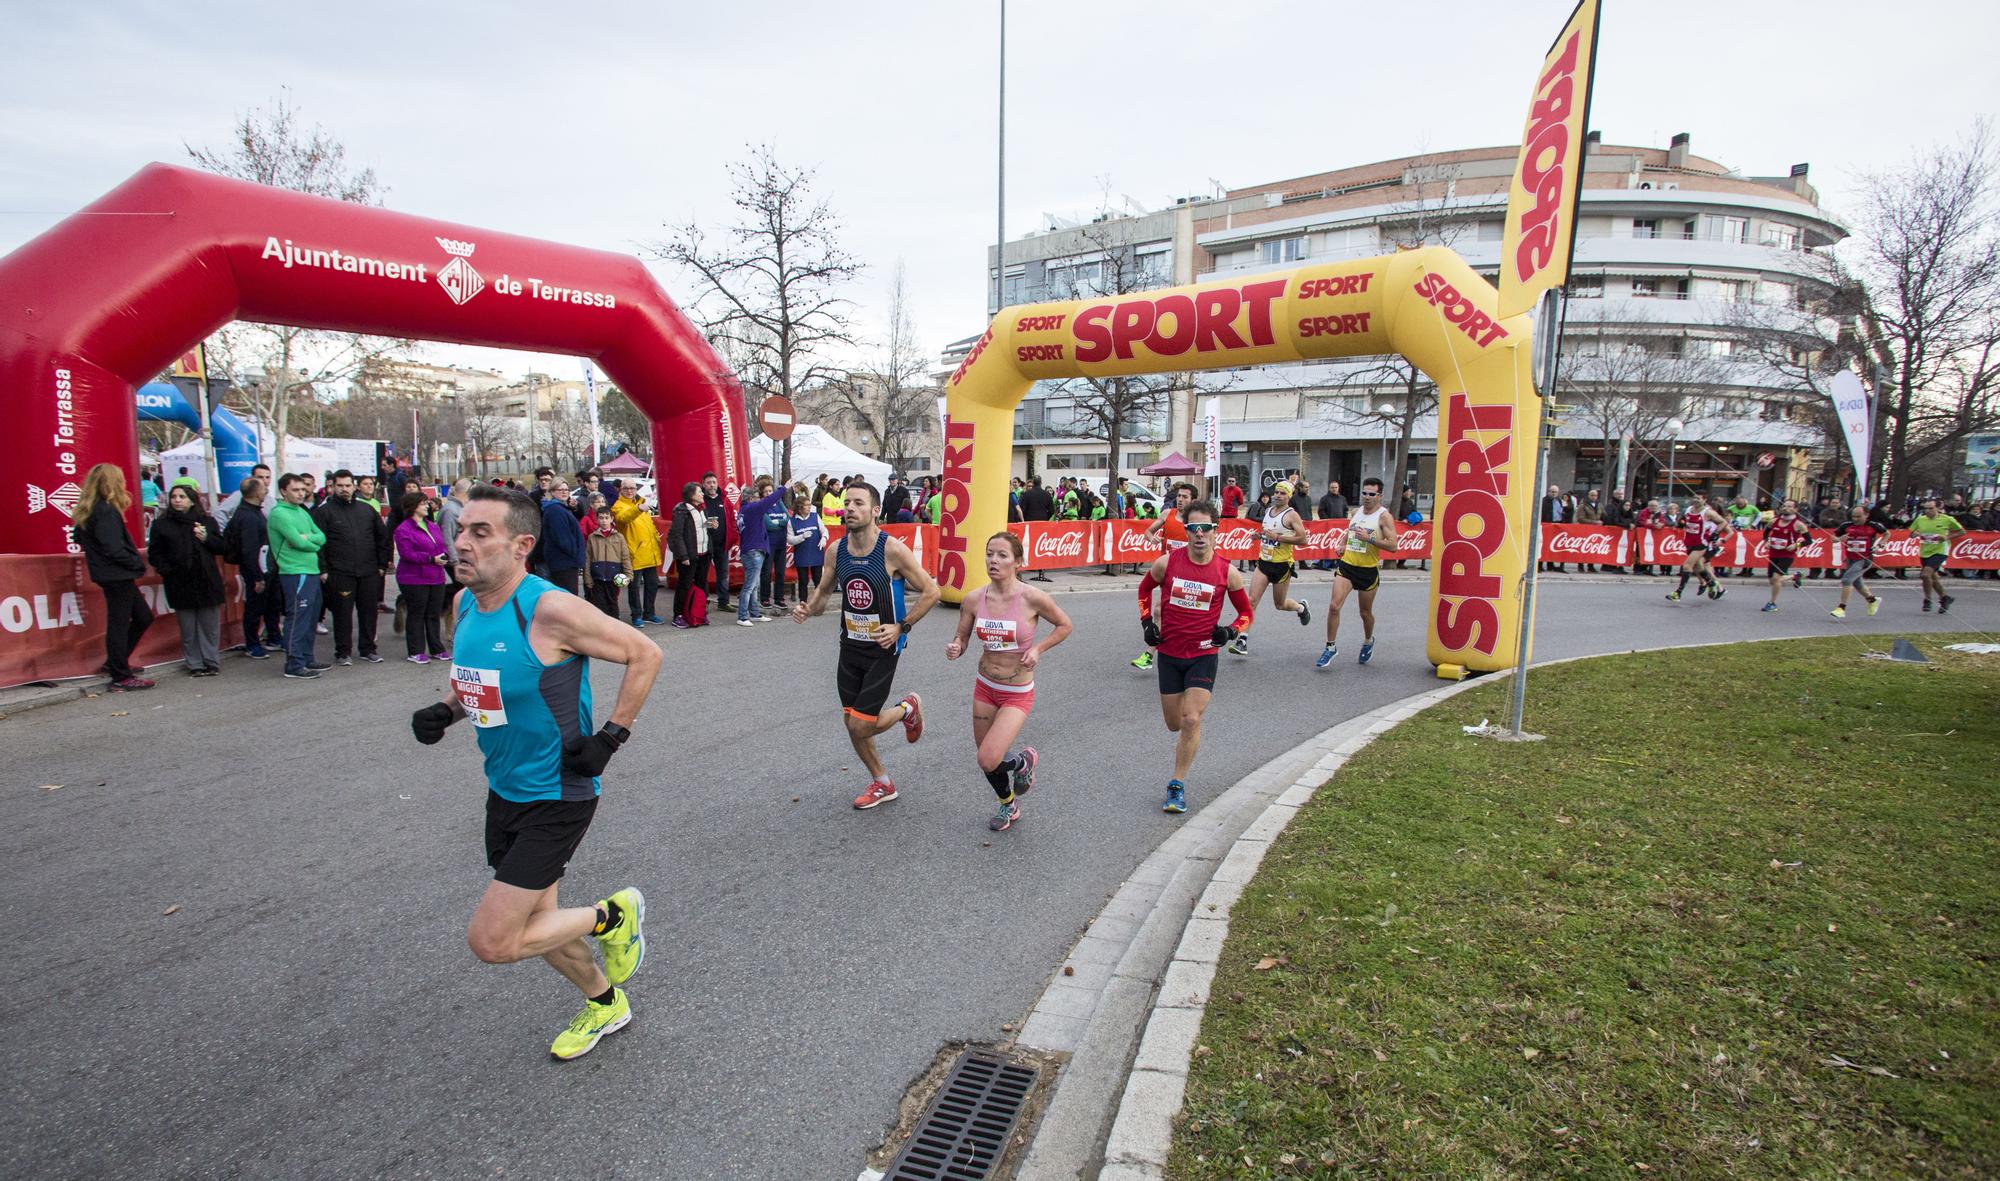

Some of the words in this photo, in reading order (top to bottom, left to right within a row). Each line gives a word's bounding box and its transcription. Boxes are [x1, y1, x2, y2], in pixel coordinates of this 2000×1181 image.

[261, 237, 427, 283] Ajuntament
[494, 274, 523, 296] de
[527, 278, 616, 309] Terrassa
[1299, 273, 1374, 299] SPORT
[1073, 279, 1288, 363] SPORT
[1413, 272, 1509, 348] SPORT
[1017, 315, 1066, 332] SPORT
[1298, 312, 1371, 338] SPORT
[952, 325, 994, 386] SPORT
[1017, 344, 1063, 362] SPORT
[54, 368, 73, 447] Terrassa
[719, 410, 734, 479] Ajuntament
[56, 452, 76, 475] de
[937, 414, 975, 591] SPORT
[1437, 393, 1513, 657] SPORT
[1035, 531, 1084, 557] Coca-Cola
[1550, 532, 1614, 555] Coca-Cola
[849, 589, 871, 600] RRR
[1183, 581, 1202, 590] BBVA
[1178, 600, 1195, 608] CIRSA
[985, 621, 1003, 629] BBVA
[457, 668, 481, 683] BBVA
[456, 681, 485, 695] MIGUEL
[463, 695, 478, 708] 835
